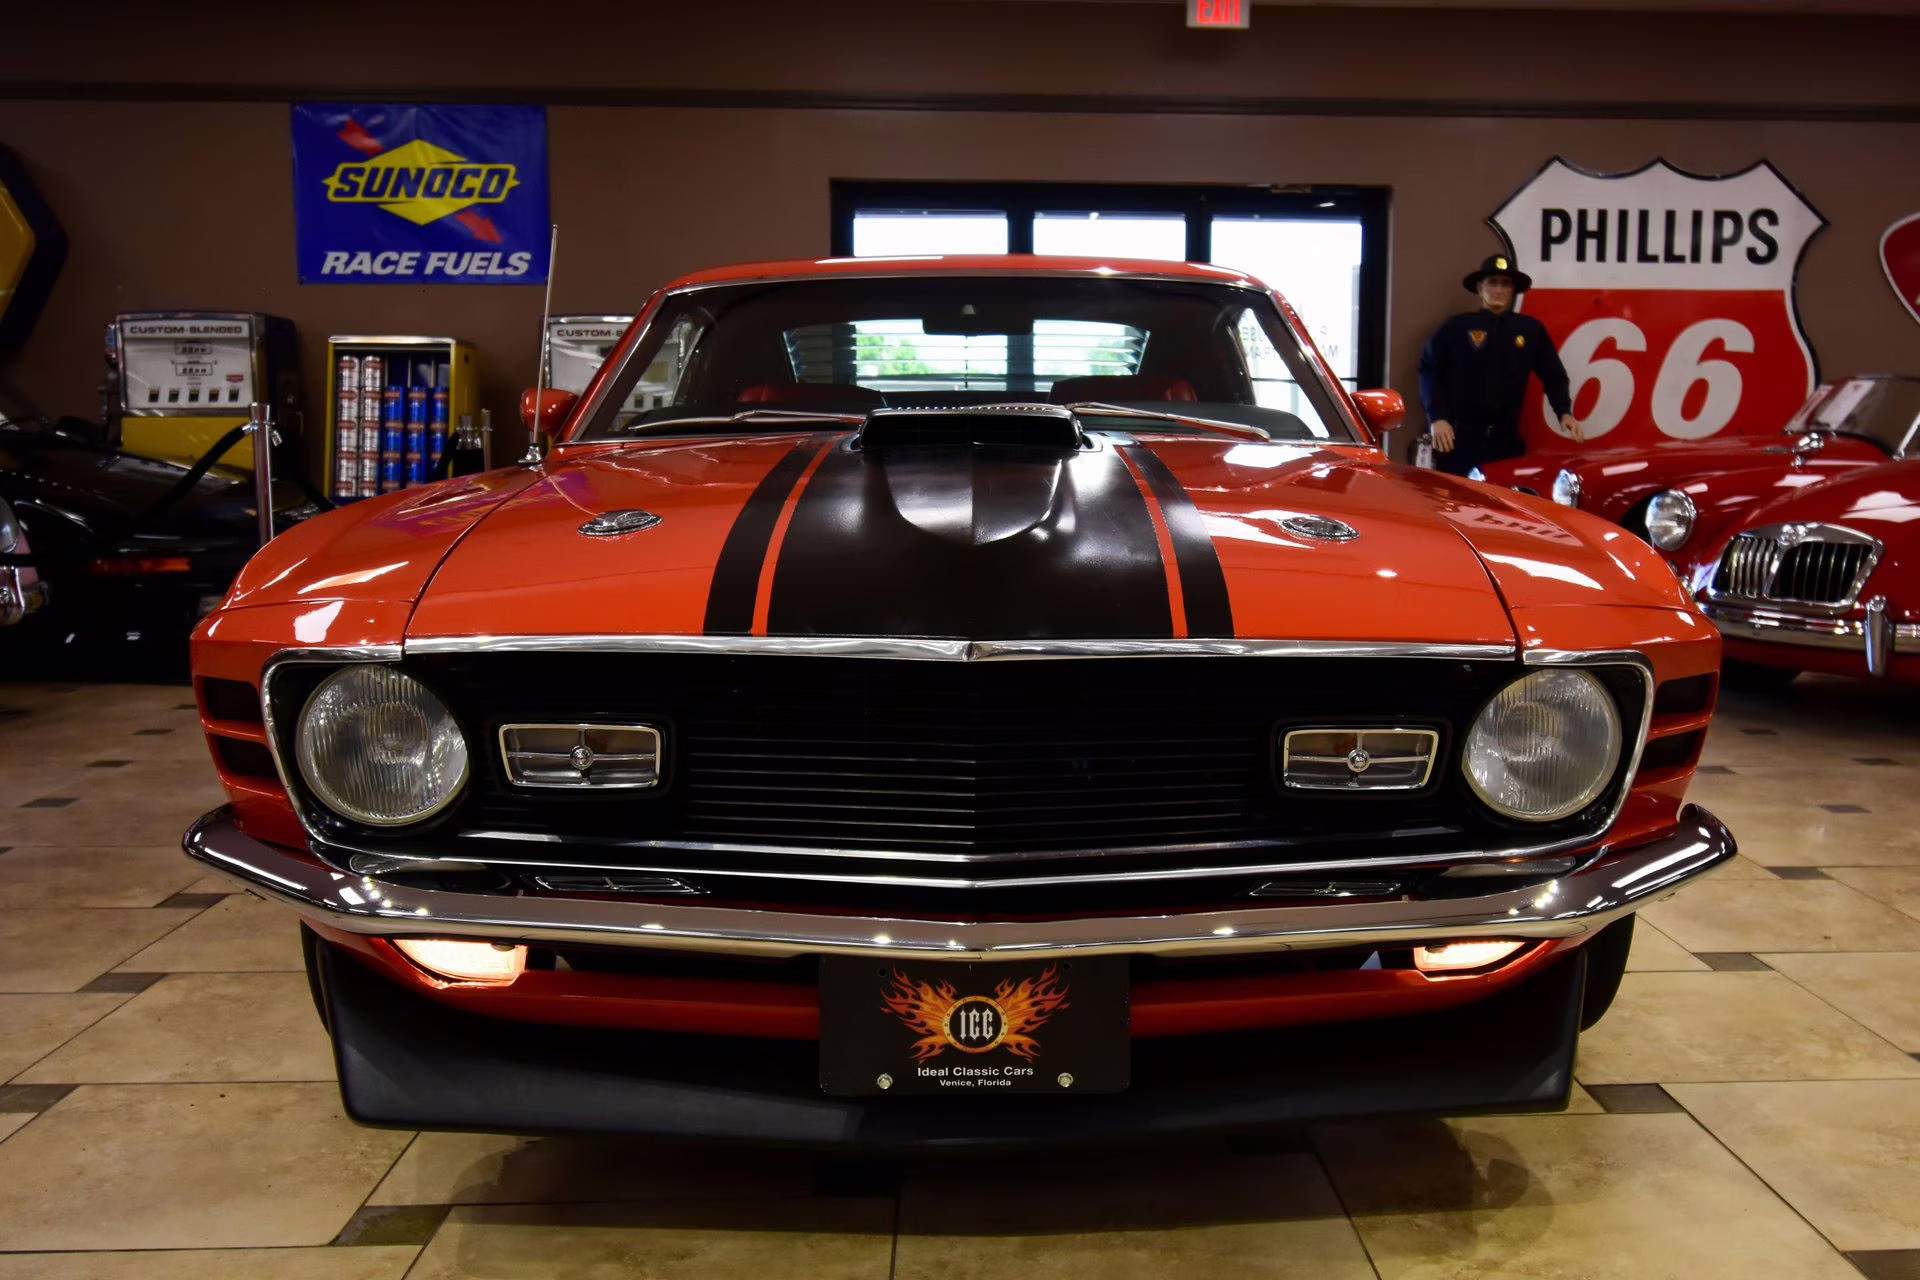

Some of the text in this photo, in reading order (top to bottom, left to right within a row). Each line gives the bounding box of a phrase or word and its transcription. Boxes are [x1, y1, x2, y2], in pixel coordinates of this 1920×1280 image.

[1198, 0, 1240, 24] EXIT
[332, 166, 510, 199] SUNOCO
[1541, 208, 1780, 265] PHILLIPS
[321, 251, 532, 276] RACE FUELS
[130, 325, 243, 334] CUSTOM-BLENDED
[557, 329, 624, 337] CUSTOM-B
[1542, 317, 1755, 440] 66
[960, 1008, 993, 1040] ICC
[917, 1066, 1034, 1077] Ideal Classic Cars
[939, 1078, 1012, 1087] Venice, Florida
